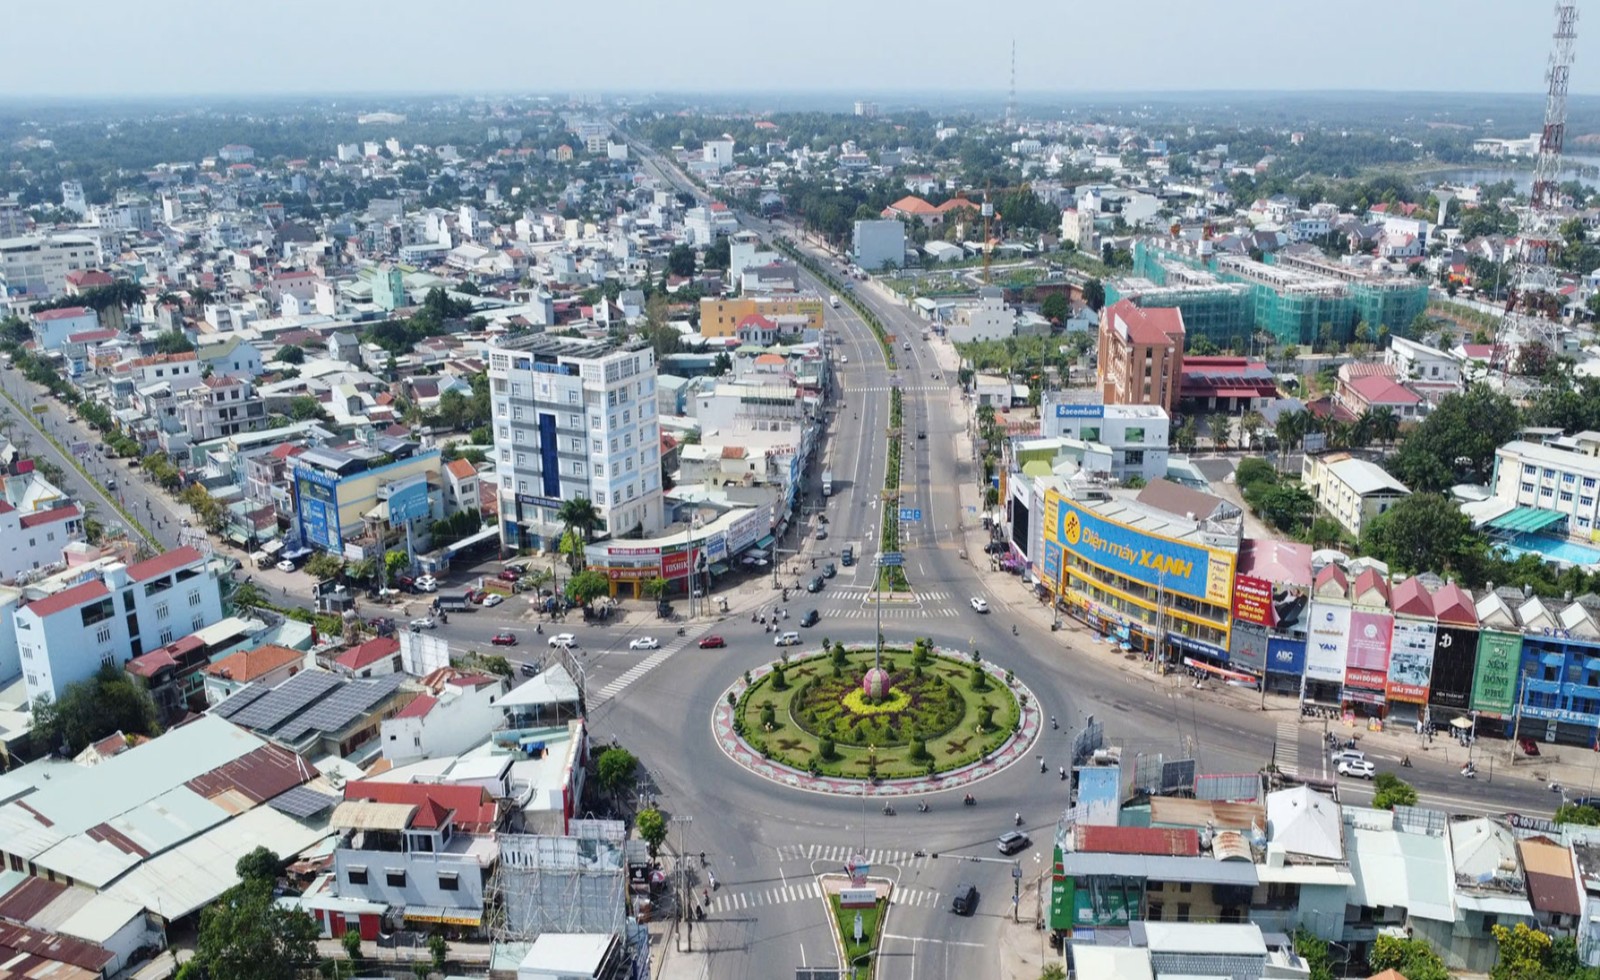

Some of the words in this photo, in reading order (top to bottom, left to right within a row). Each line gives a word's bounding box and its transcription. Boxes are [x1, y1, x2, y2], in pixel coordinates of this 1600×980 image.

[1059, 406, 1102, 416] Sacombank
[1082, 527, 1107, 551] Điện
[1108, 543, 1138, 565] máy
[1138, 549, 1193, 578] XANH
[1319, 643, 1337, 651] YAN
[1276, 650, 1293, 660] ABC
